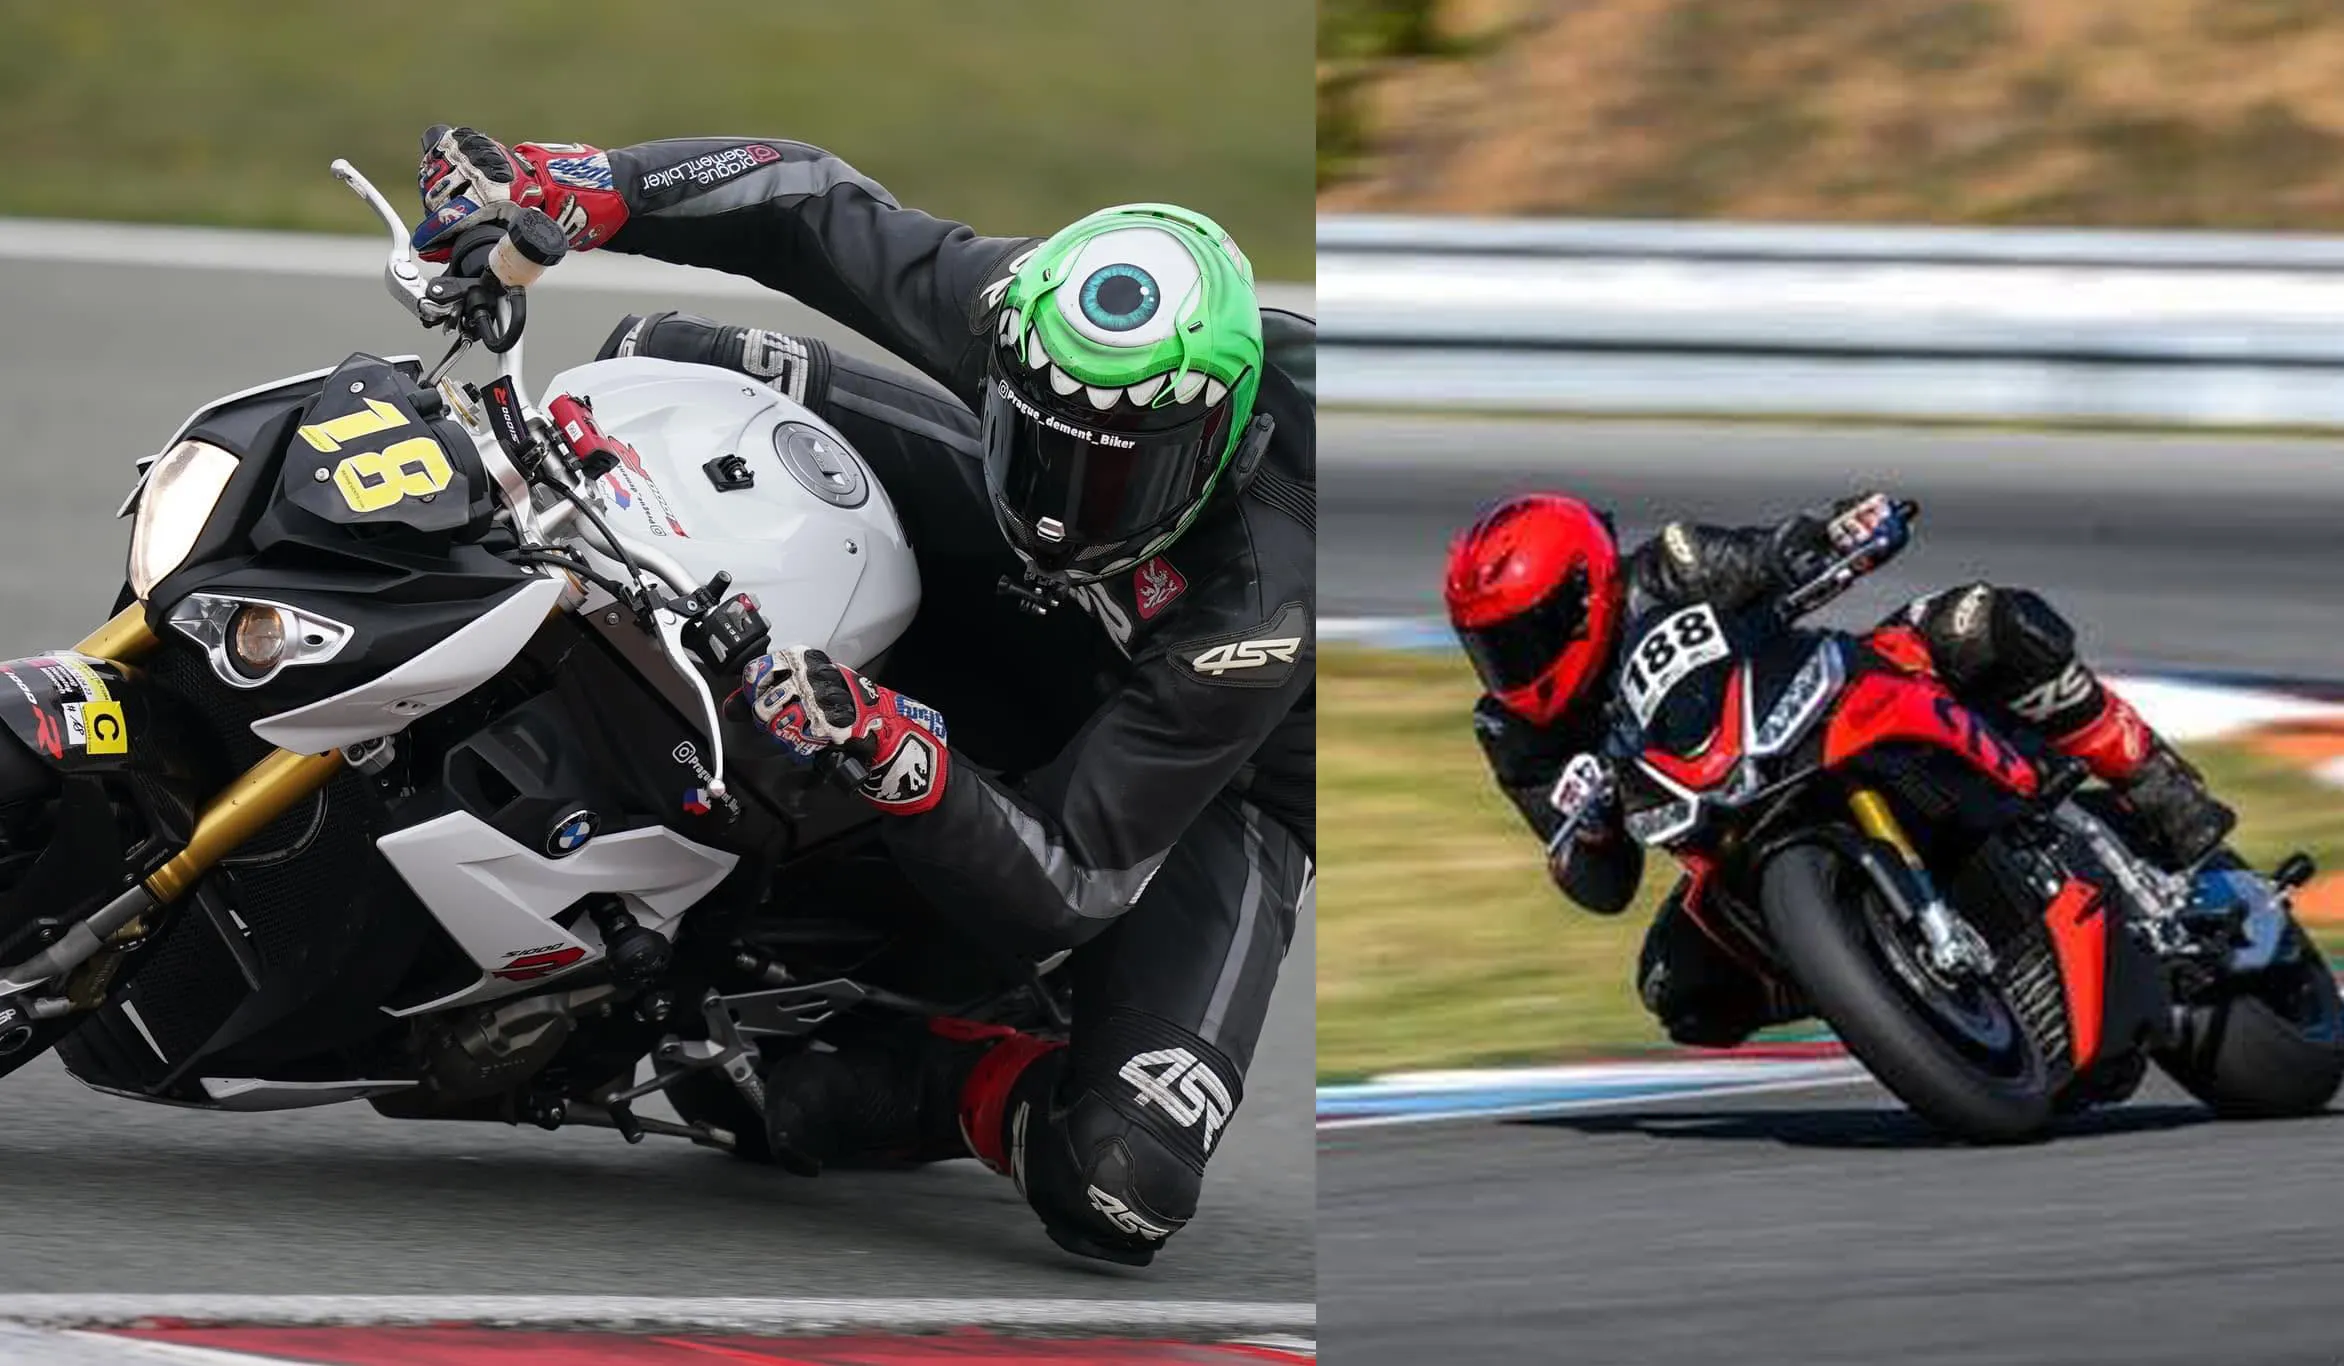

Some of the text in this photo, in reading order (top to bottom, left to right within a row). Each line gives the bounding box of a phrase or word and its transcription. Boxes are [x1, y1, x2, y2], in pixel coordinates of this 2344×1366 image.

[697, 154, 758, 184] prague
[1007, 389, 1136, 449] Prague_dement_Biker
[298, 397, 454, 513] 18
[1192, 637, 1302, 676] 4SR
[1626, 611, 1715, 697] 188
[93, 713, 120, 742] C
[1118, 1046, 1234, 1152] 4SR
[1087, 1184, 1170, 1241] 4SR
